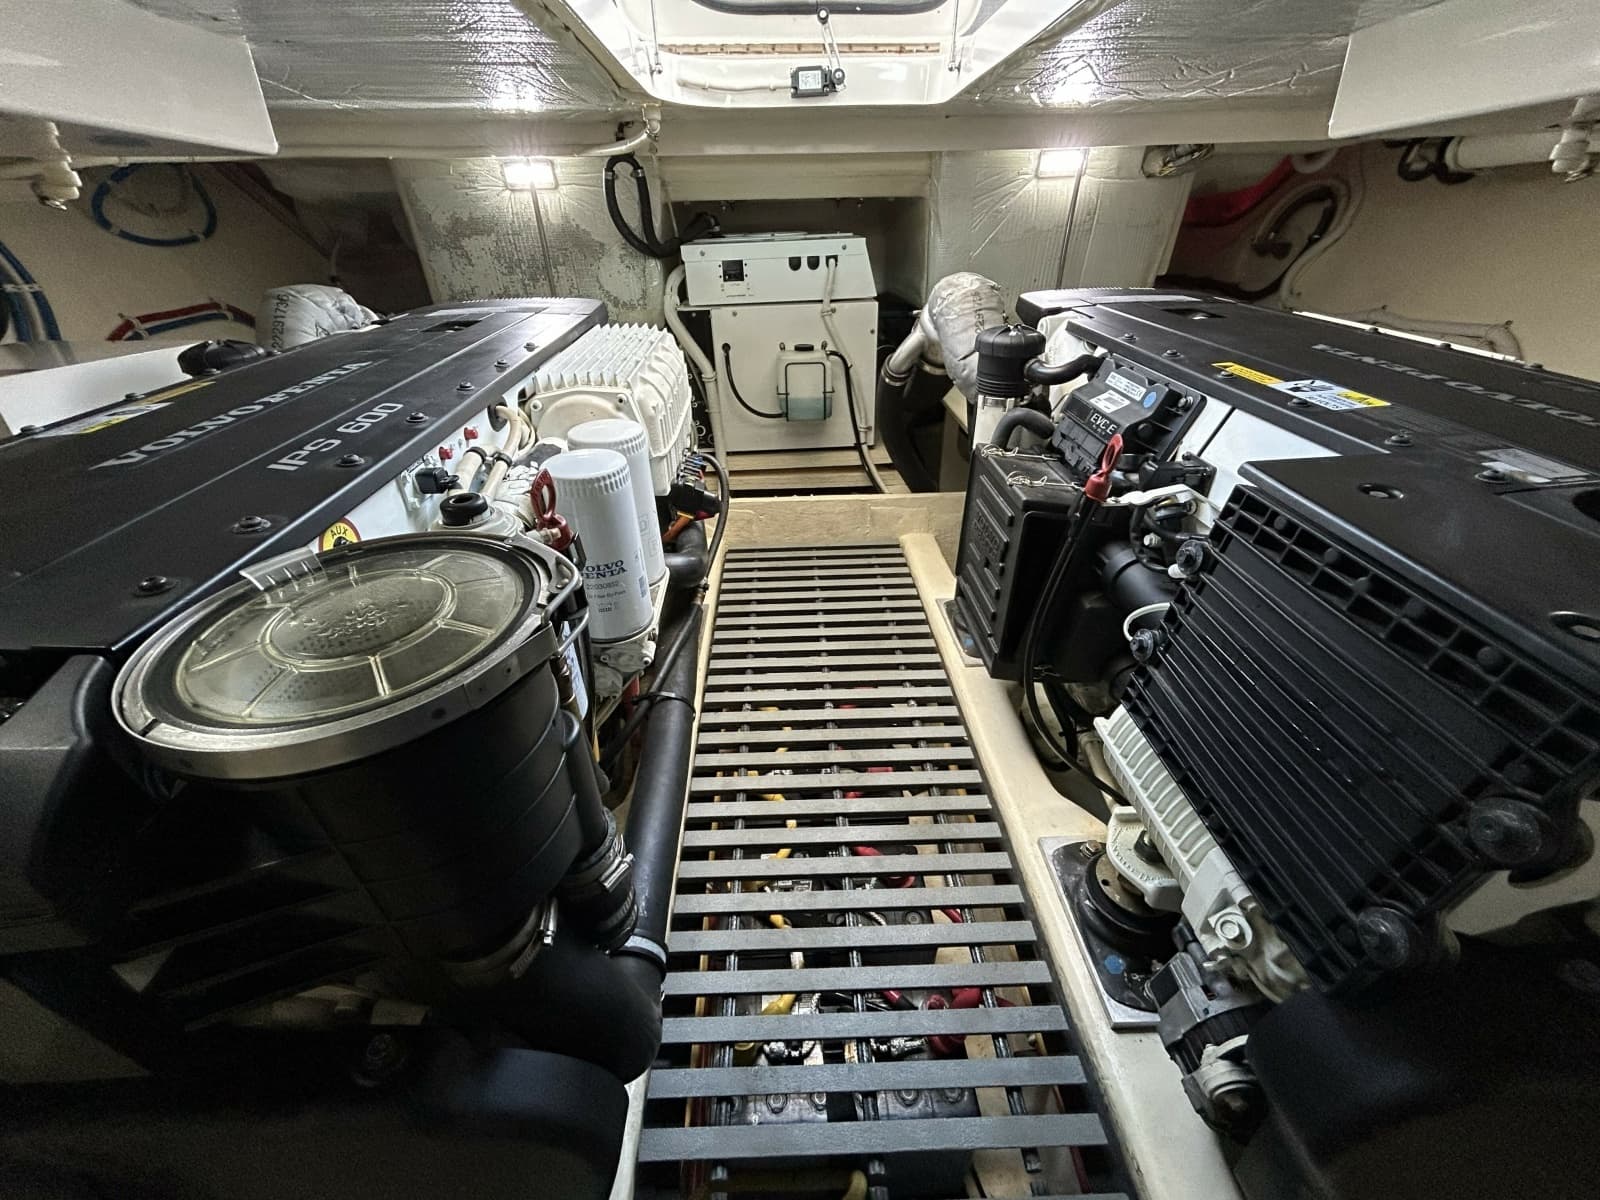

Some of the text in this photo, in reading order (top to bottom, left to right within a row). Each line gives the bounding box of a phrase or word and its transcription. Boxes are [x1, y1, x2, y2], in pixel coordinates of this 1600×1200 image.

[88, 404, 265, 471] VOLVO
[260, 361, 374, 403] PENTA
[266, 403, 404, 471] IPS 600
[330, 525, 348, 540] AUX
